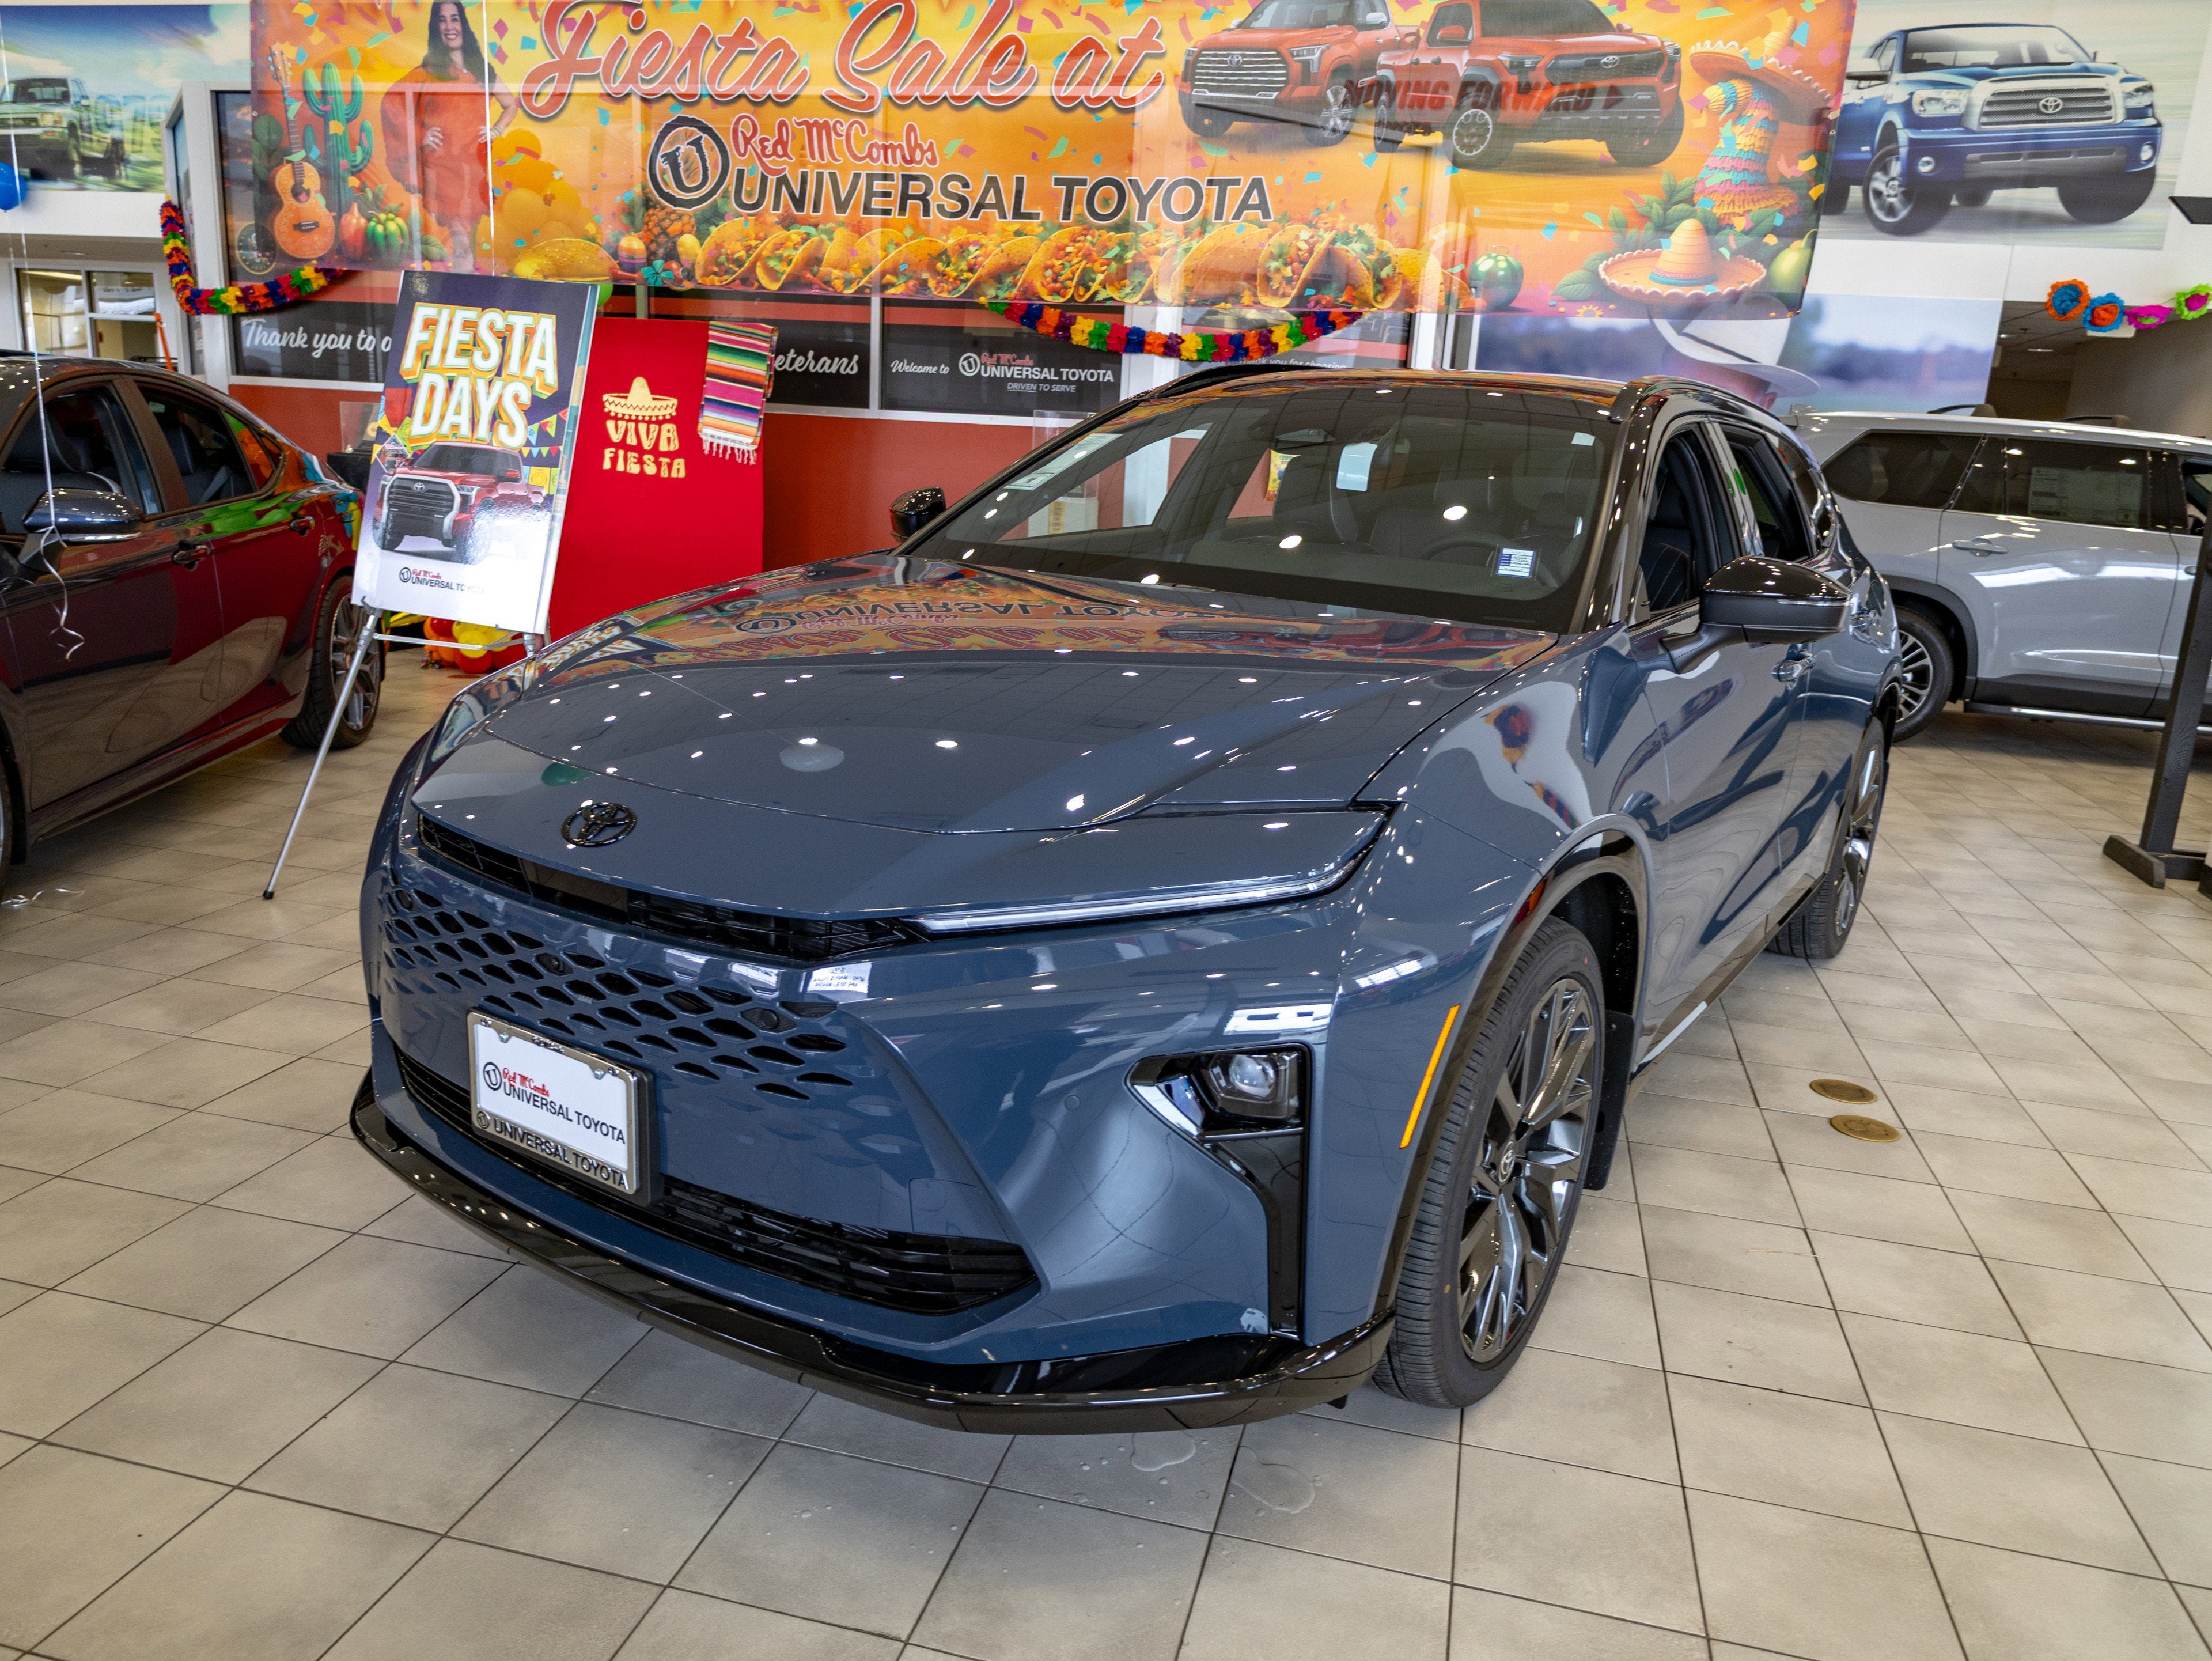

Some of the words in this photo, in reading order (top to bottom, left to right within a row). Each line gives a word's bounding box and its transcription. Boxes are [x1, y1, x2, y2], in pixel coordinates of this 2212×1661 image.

[520, 0, 809, 117] Fiesta
[821, 0, 1037, 112] Sale
[1052, 16, 1165, 108] at
[1454, 80, 1596, 111] FORWARD
[731, 113, 796, 177] Red
[793, 117, 939, 167] McCombs
[732, 167, 1042, 222] UNIVERSAL
[1052, 175, 1272, 224] TOYOTA
[241, 318, 309, 348] Thank
[312, 332, 353, 358] you
[357, 329, 376, 351] to
[401, 303, 558, 388] FIESTA
[774, 348, 859, 374] eterans
[891, 359, 937, 374] Welcome
[939, 361, 950, 374] to
[980, 353, 997, 367] Red
[980, 365, 1060, 380] UNIVERSAL
[1060, 369, 1114, 382] TOYOTA
[1007, 382, 1036, 391] DRIVEN
[1039, 384, 1050, 392] TO
[1051, 384, 1076, 392] SERVE
[409, 370, 531, 449] DAYS
[606, 419, 679, 451] VIVA
[603, 447, 685, 478] FIESTA
[411, 576, 454, 590] UNIVERSAL
[503, 1068, 517, 1087] Red
[518, 1073, 550, 1097] McCombs
[503, 1081, 574, 1122] UNIVERSAL
[574, 1110, 626, 1145] TOYOTA
[494, 1118, 573, 1164] UNIVERSAL
[573, 1151, 630, 1190] TOYOTA
